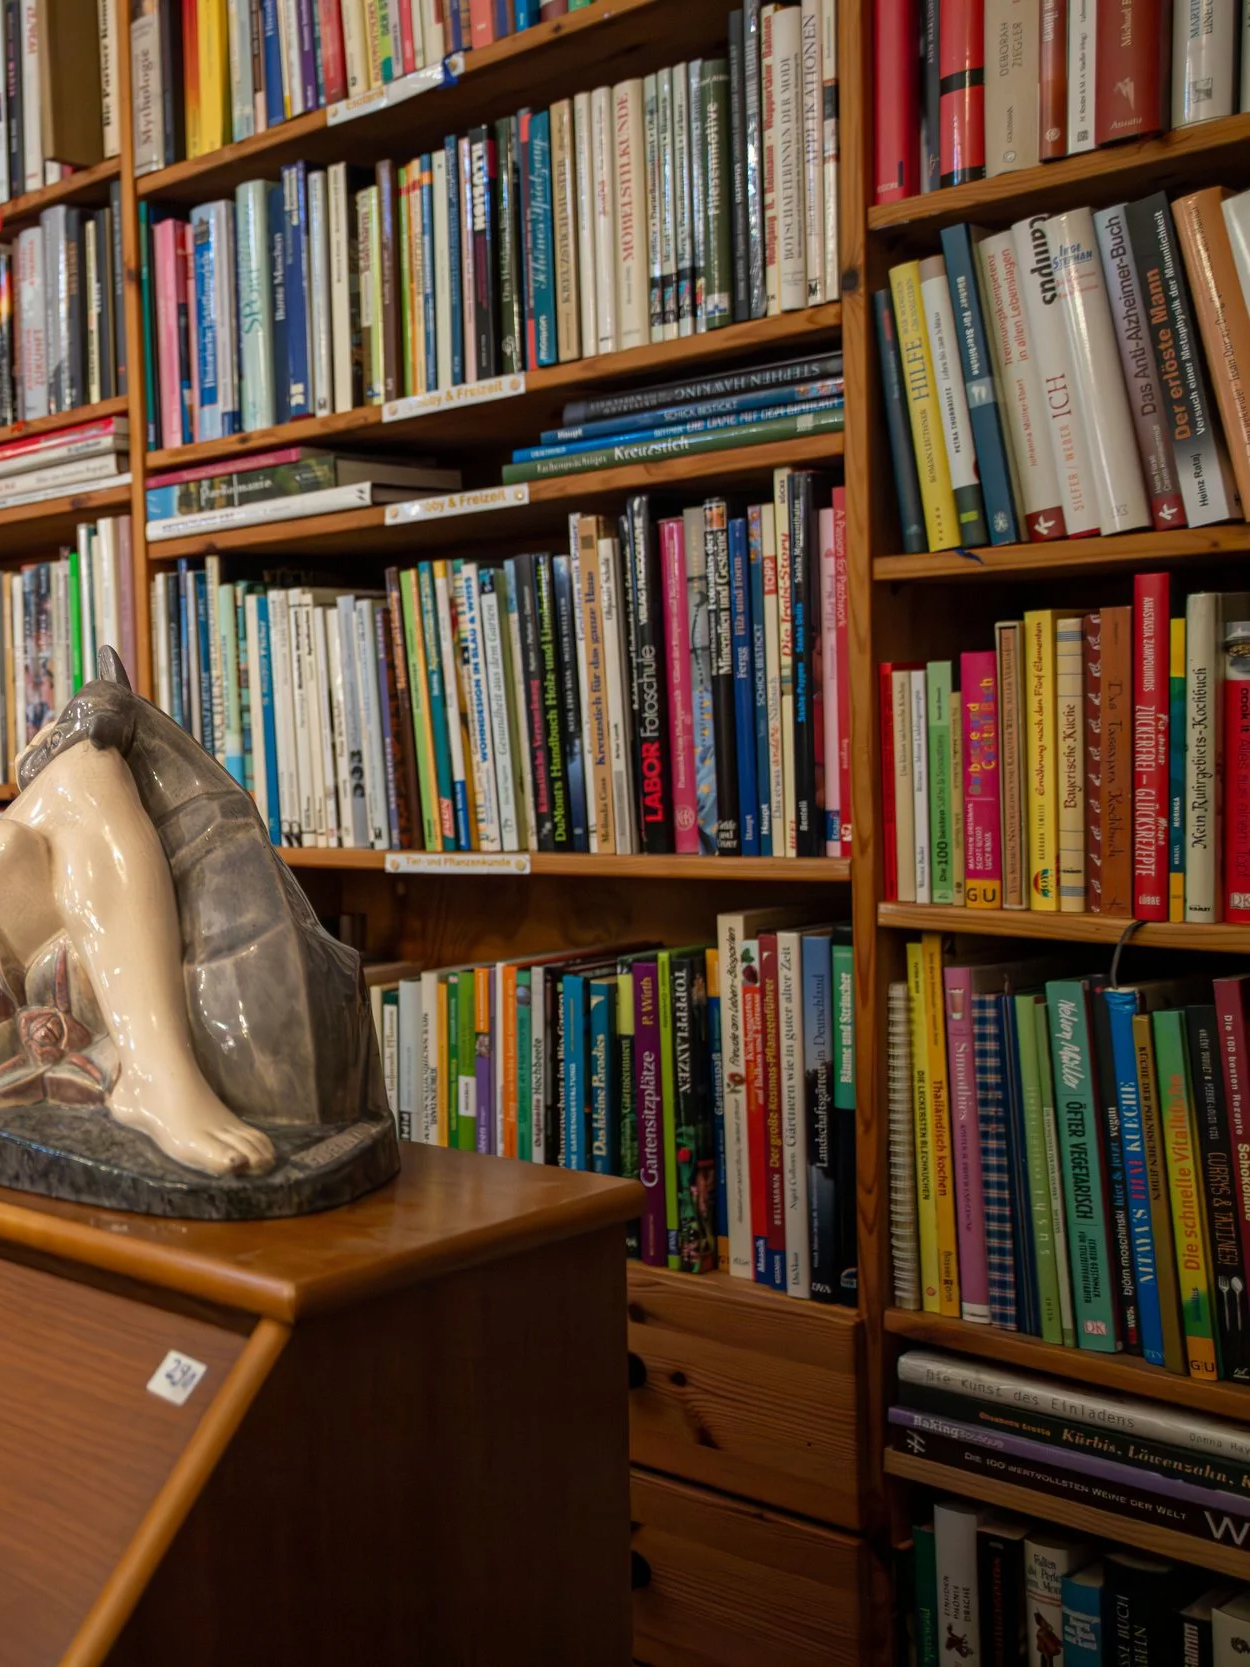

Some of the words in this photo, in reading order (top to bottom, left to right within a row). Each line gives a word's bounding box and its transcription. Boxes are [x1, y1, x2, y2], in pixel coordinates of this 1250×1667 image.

[762, 13, 772, 57] Bahnen
[998, 21, 1010, 76] DEBORAH
[1012, 20, 1023, 67] ZIEGLER
[138, 47, 154, 144] Mythologie
[762, 62, 773, 129] Wuppertaler
[780, 95, 792, 123] DER
[802, 13, 818, 164] APPLIKATIONEN
[705, 100, 721, 216] Fliesenmotive
[781, 127, 795, 260] BOTSCHAFTERINNEN
[556, 158, 571, 303] KREUZSTICHMUSTER
[765, 215, 777, 265] Wolfgang
[1153, 210, 1176, 277] Männlichkeit
[1000, 247, 1023, 317] Lebenslagen
[1104, 213, 1151, 378] Anti-Alzheimer-Buch
[1145, 266, 1169, 324] Mann
[1167, 278, 1180, 296] der
[986, 252, 1013, 365] Trennungskompetenz
[1170, 298, 1192, 359] Metaphysik
[1011, 319, 1026, 347] allen
[750, 364, 821, 384] STEPHEN
[903, 336, 929, 400] HILFE
[1017, 349, 1029, 361] in
[1155, 326, 1183, 398] erlöste
[1184, 360, 1197, 388] einer
[445, 390, 454, 401] &
[456, 380, 503, 400] Freizeit
[674, 377, 746, 398] HAWKING
[1045, 371, 1072, 417] ICH
[1139, 382, 1158, 415] Das
[1172, 403, 1192, 440] Der
[1189, 390, 1206, 434] Versuch
[613, 436, 691, 461] Kreuzstich
[447, 494, 456, 508] &
[459, 491, 506, 507] Freizeit
[1194, 478, 1210, 506] Heinz
[834, 509, 845, 518] A
[704, 532, 715, 552] der
[714, 529, 729, 582] Gesteine
[833, 519, 845, 555] Passion
[584, 570, 596, 603] Haus
[834, 557, 845, 574] for
[463, 575, 475, 612] WEISS
[716, 583, 730, 607] und
[834, 575, 846, 628] Patchwork
[468, 615, 477, 625] &
[484, 602, 497, 641] Garten
[588, 608, 601, 644] ganze
[1140, 596, 1153, 638] ANASTASIA
[469, 627, 478, 658] BLAU
[488, 643, 500, 666] dem
[542, 643, 554, 668] und
[590, 646, 600, 668] das
[716, 609, 732, 675] Mineralien
[754, 622, 764, 668] BESTICKT
[472, 662, 481, 674] IN
[492, 670, 501, 690] aus
[544, 670, 556, 704] Holz
[591, 671, 603, 692] für
[1141, 639, 1154, 693] ZAMPOUNIDIS
[637, 643, 660, 737] Fotoschule
[755, 670, 765, 706] SCHICK
[1034, 697, 1044, 716] den
[474, 678, 488, 762] WOHNDESIGN
[494, 692, 509, 755] Gesundheit
[530, 678, 542, 745] Versuchung
[594, 695, 607, 765] Kreuzstich
[1034, 718, 1045, 741] nach
[1063, 702, 1077, 742] Küche
[547, 708, 562, 776] Handbuch
[1190, 666, 1215, 811] Ruhrgebiets-Kochbuch
[536, 749, 548, 813] Künstliche
[641, 740, 664, 822] LABOR
[1063, 743, 1082, 808] Bayerische
[553, 780, 567, 841] DuMont's
[759, 802, 770, 834] Haupt
[1191, 814, 1207, 848] Mein
[443, 857, 511, 867] Pflanzenkunde
[984, 854, 992, 869] LUCY
[641, 975, 654, 1014] Wirth
[811, 972, 827, 1046] Deutschland
[838, 971, 852, 1023] Sträucher
[672, 968, 688, 1094] TOPFPFLANZEN
[762, 976, 779, 1110] Kosmos-Pflanzenführer
[839, 1024, 852, 1045] und
[592, 1032, 606, 1087] Paradies
[839, 1047, 852, 1083] Bäume
[915, 1070, 924, 1084] DIE
[1056, 1043, 1084, 1090] Müller
[954, 1041, 969, 1121] Smoothies
[593, 1088, 607, 1128] kleine
[638, 1049, 660, 1187] Gartensitzplätze
[767, 1111, 780, 1145] große
[814, 1064, 830, 1167] Landschaftsgärten
[916, 1086, 928, 1138] LECKERSTEN
[931, 1080, 946, 1152] Thailändisch
[1064, 1101, 1090, 1141] ÖFTER
[593, 1129, 607, 1156] Das
[767, 1146, 780, 1166] Der
[934, 1155, 949, 1197] kochen
[1068, 1143, 1094, 1220] VEGETARISCH
[1206, 1152, 1232, 1196] CURRYS
[1175, 1166, 1198, 1238] schnelle
[1212, 1198, 1233, 1210] &
[1181, 1243, 1200, 1270] Die
[1189, 1359, 1215, 1373] GU
[926, 1368, 952, 1384] Die
[960, 1377, 1004, 1398] Kunst
[1013, 1389, 1040, 1407] des
[1051, 1398, 1136, 1430] Einladens
[1189, 1432, 1223, 1450] Donna
[964, 1451, 983, 1465] DIE
[986, 1459, 1006, 1470] 100
[1008, 1464, 1089, 1494] WERTVOLLSTEN
[1092, 1487, 1127, 1504] WEINE
[1130, 1498, 1153, 1512] DER
[1156, 1506, 1187, 1521] WELT
